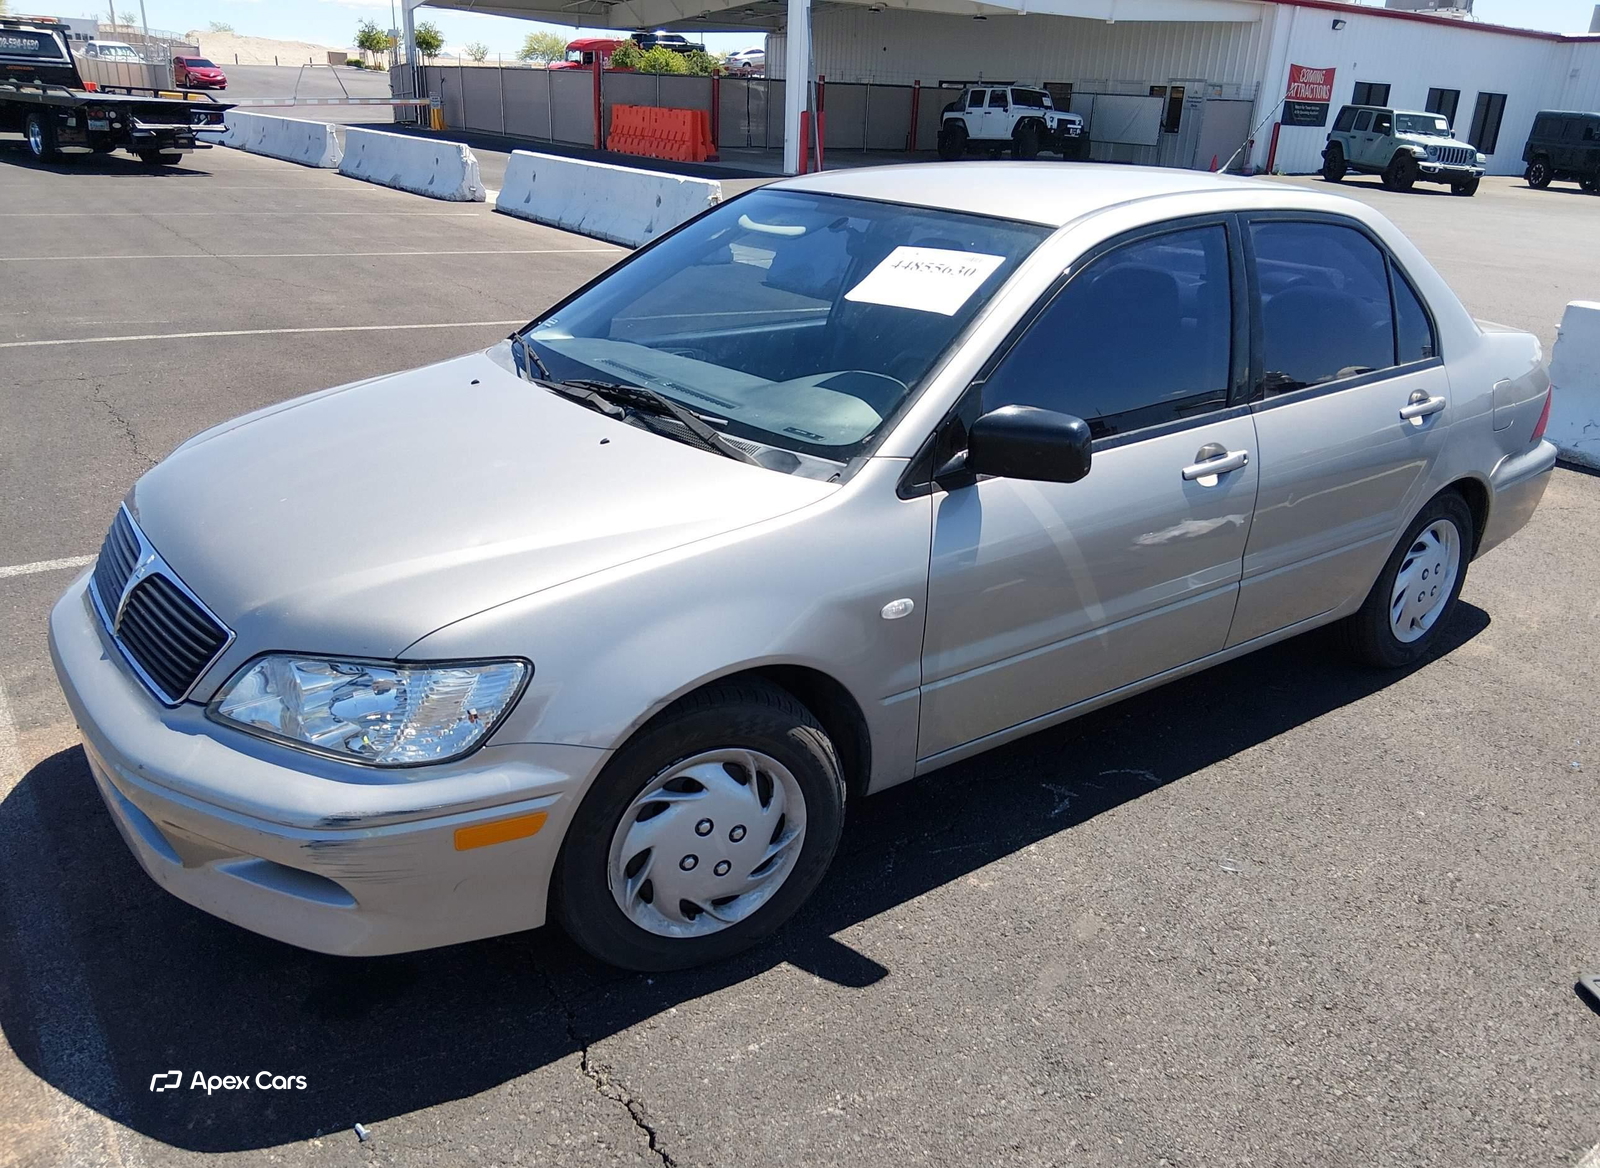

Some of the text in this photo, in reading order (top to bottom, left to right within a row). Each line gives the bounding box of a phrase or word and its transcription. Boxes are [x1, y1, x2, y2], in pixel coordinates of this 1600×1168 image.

[1300, 68, 1325, 83] COMING
[1288, 82, 1330, 99] ATTRACTIONS
[891, 260, 977, 277] 44855630
